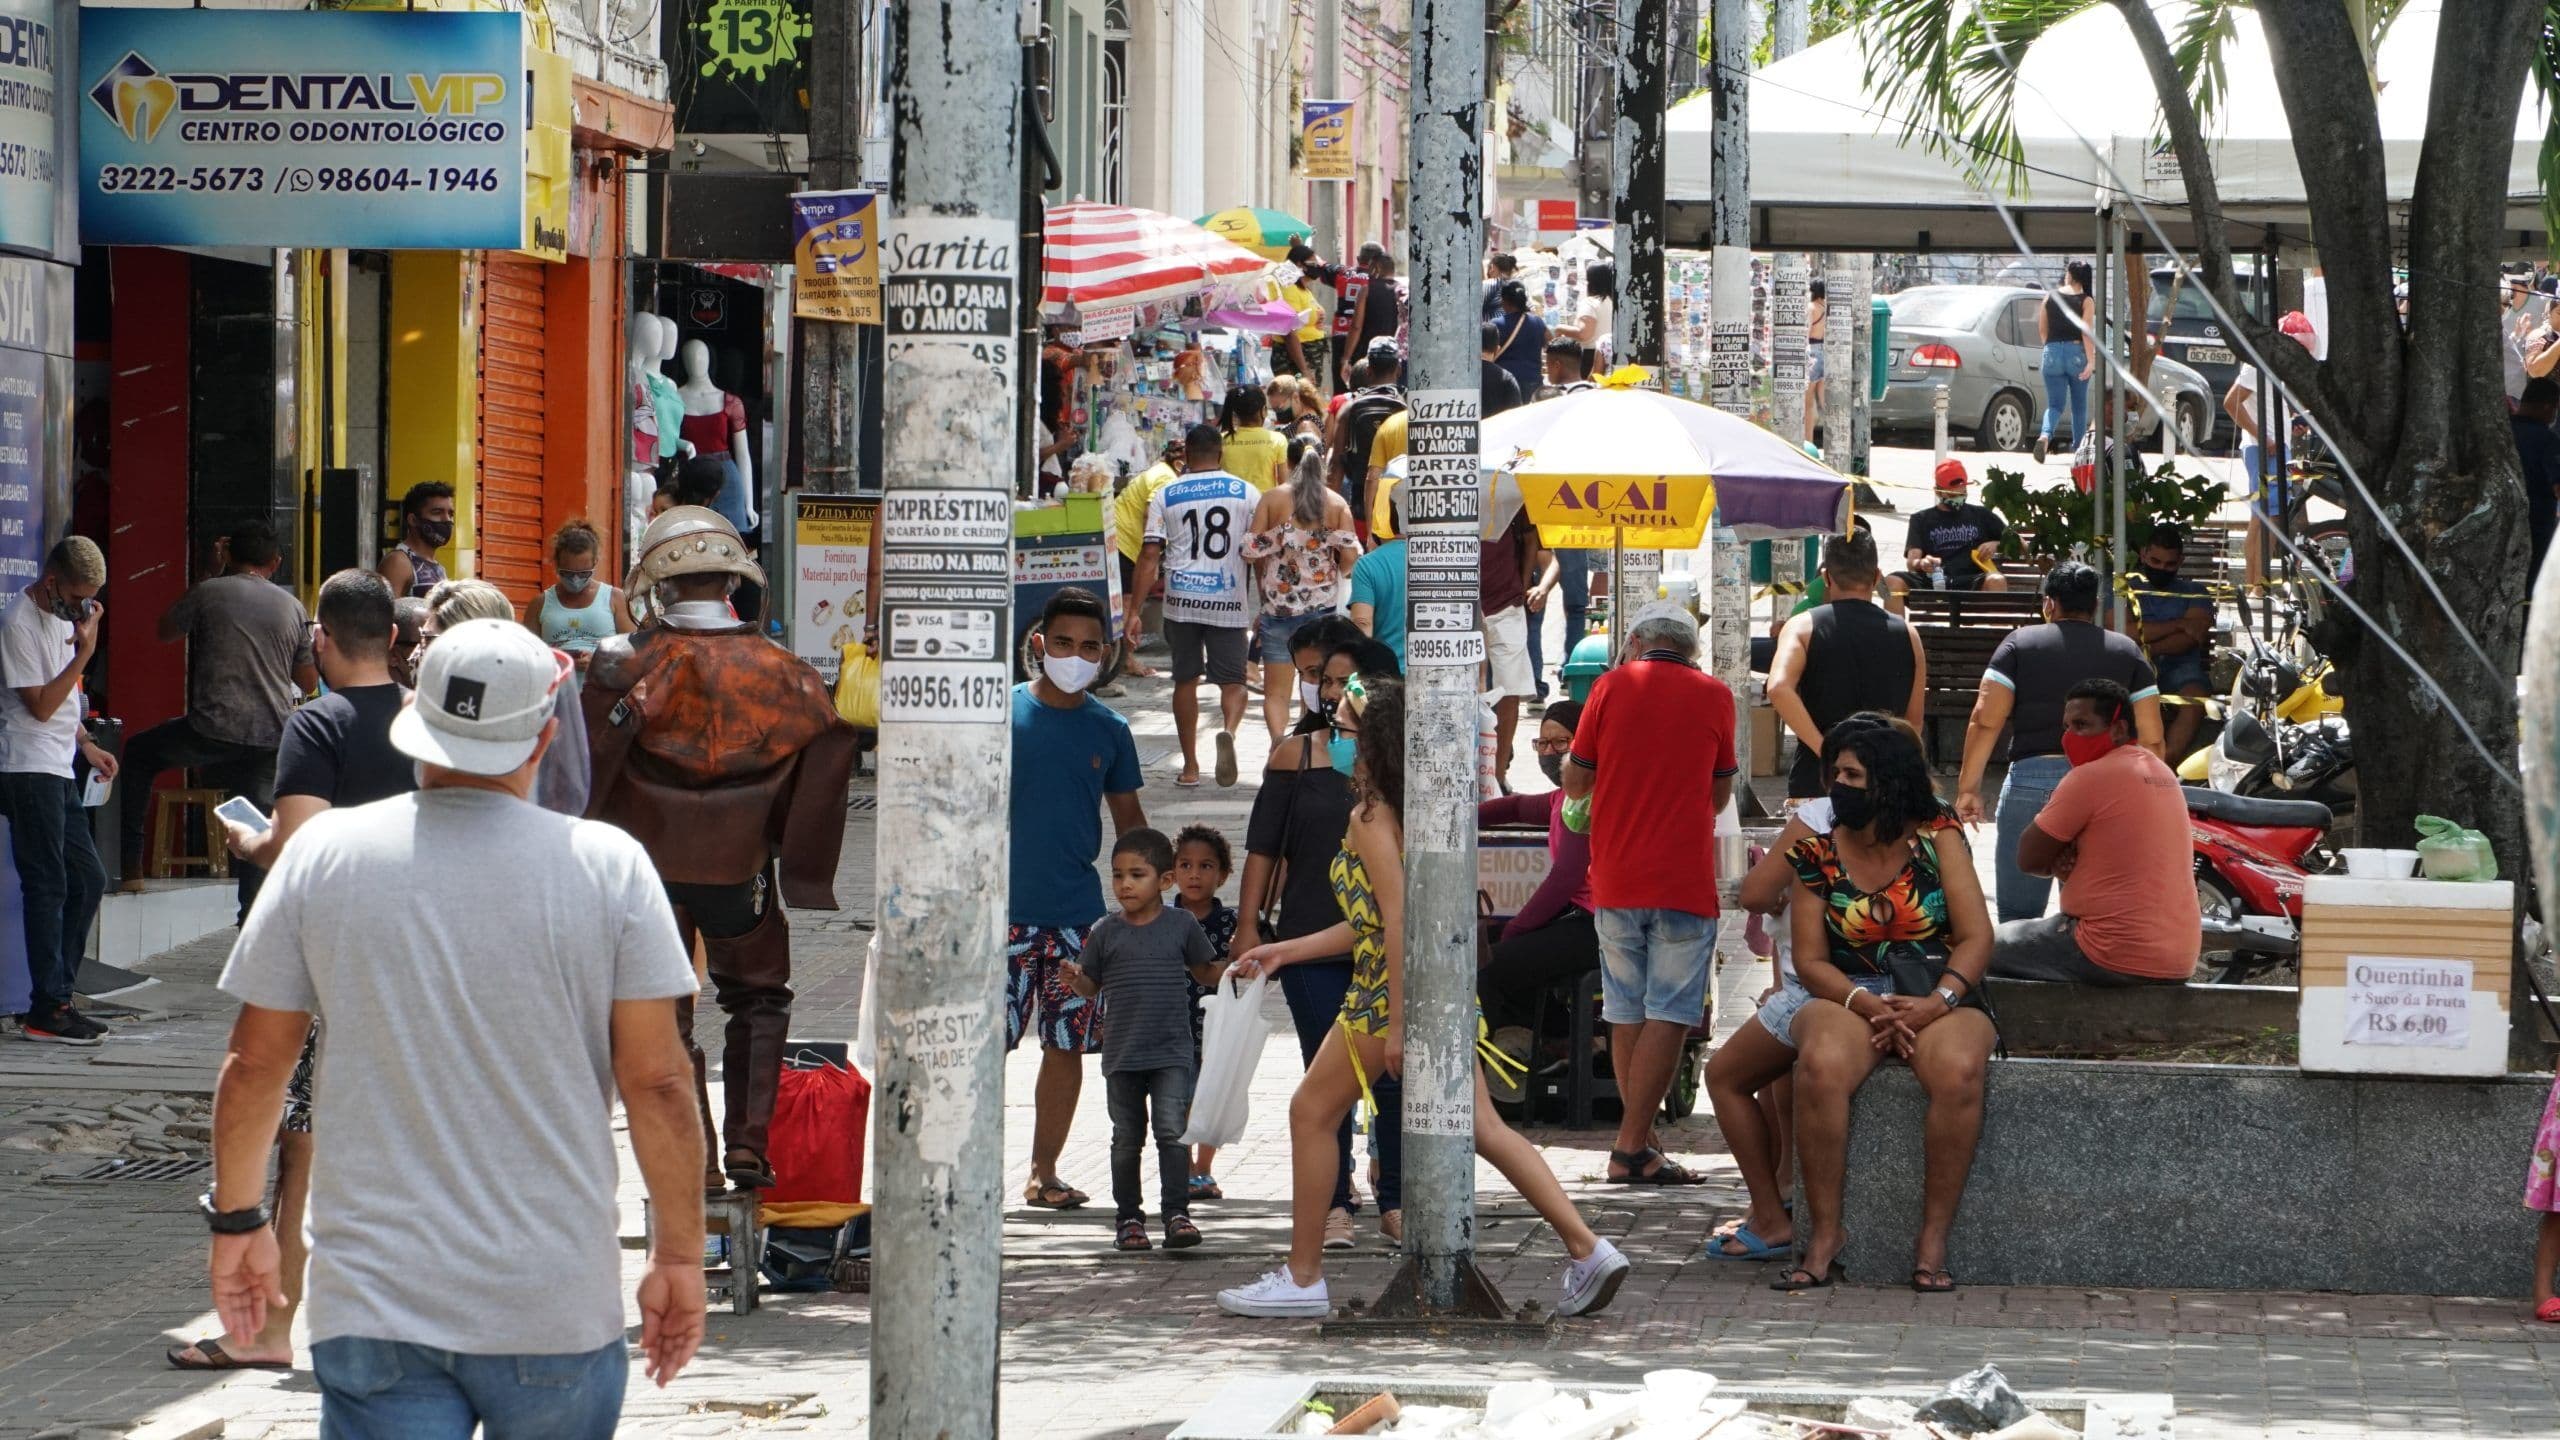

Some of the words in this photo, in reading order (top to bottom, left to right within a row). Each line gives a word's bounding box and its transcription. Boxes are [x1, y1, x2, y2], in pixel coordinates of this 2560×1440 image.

[720, 9, 774, 55] 13
[180, 121, 281, 142] CENTRO
[289, 116, 505, 142] ODONTOLÓGICO
[101, 166, 264, 192] 3222-5673
[318, 167, 498, 192] 98604-1946
[794, 199, 835, 217] Sempre
[888, 232, 1010, 274] Sarita
[803, 277, 831, 288] TROQUE
[888, 279, 947, 308] UNIÃO
[953, 284, 1007, 309] PARA
[901, 307, 916, 331] O
[920, 307, 988, 331] AMOR
[1711, 353, 1749, 361] CARTAS
[1408, 398, 1477, 422] Sarita
[1409, 423, 1443, 441] UNIÃO
[1446, 425, 1476, 440] PARA
[1417, 439, 1426, 453] O
[1428, 439, 1467, 453] AMOR
[1408, 458, 1477, 472] CARTAS
[1168, 479, 1225, 497] Elizabeth
[1408, 472, 1478, 487] TARÔ
[1548, 475, 1668, 518] AÇAÍ
[818, 507, 848, 520] ZILDA
[886, 492, 1007, 523] EMPRÉSTIMO
[896, 524, 940, 537] CARTÃO
[943, 526, 960, 537] DE
[962, 525, 1007, 539] CRÉDITO
[1182, 505, 1231, 561] 18
[1030, 548, 1079, 557] SORVETE
[1410, 537, 1478, 554] EMPRÉSTIMO
[824, 549, 857, 564] Fornitura
[884, 553, 944, 571] DINHEIRO
[945, 553, 970, 571] NA
[972, 554, 1007, 572] HORA
[1030, 561, 1080, 570] FRUTA
[802, 567, 832, 582] Material
[832, 569, 849, 586] para
[1172, 571, 1218, 586] Gomes
[1447, 571, 1460, 582] NA
[919, 586, 974, 601] QUALQUER
[916, 615, 944, 626] VISA
[1414, 638, 1482, 659] 99956.1875
[890, 675, 1004, 709] 99956.1875
[456, 696, 477, 718] ck
[2355, 965, 2465, 988] Quentinha
[2364, 991, 2399, 1006] Suco
[2402, 992, 2421, 1006] da
[2425, 993, 2466, 1009] Fruta
[2368, 1013, 2397, 1032] R$
[2403, 1014, 2448, 1037] 6,00
[950, 1047, 966, 1069] DE
